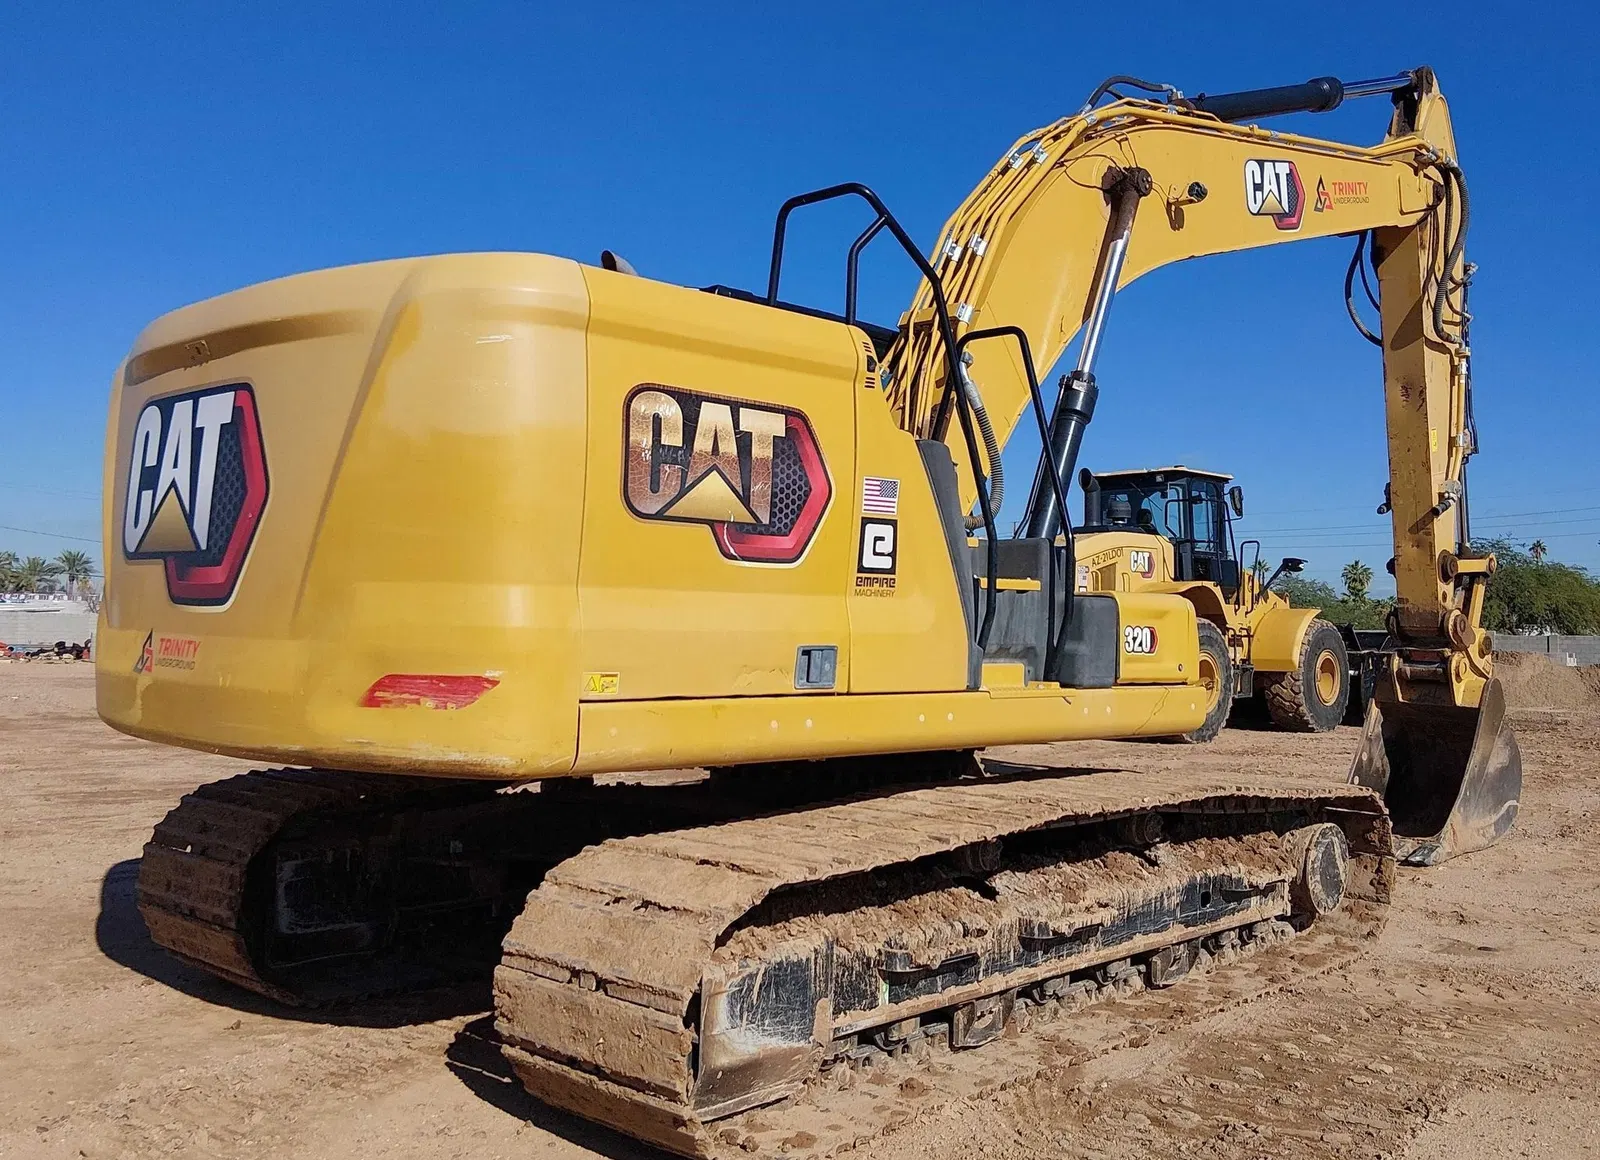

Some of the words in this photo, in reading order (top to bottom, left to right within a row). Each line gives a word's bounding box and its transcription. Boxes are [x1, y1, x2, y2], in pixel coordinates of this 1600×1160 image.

[1244, 160, 1290, 215] CAT
[1332, 181, 1369, 195] TRINITY
[1333, 196, 1370, 204] UNDERGROUND
[627, 390, 786, 525] CAT
[124, 391, 236, 553] CAT
[1130, 550, 1150, 573] CAT
[854, 588, 896, 598] MACHINERY
[158, 637, 201, 658] TRINITY
[1124, 626, 1151, 653] 320
[154, 657, 196, 670] UNDERGROUND
